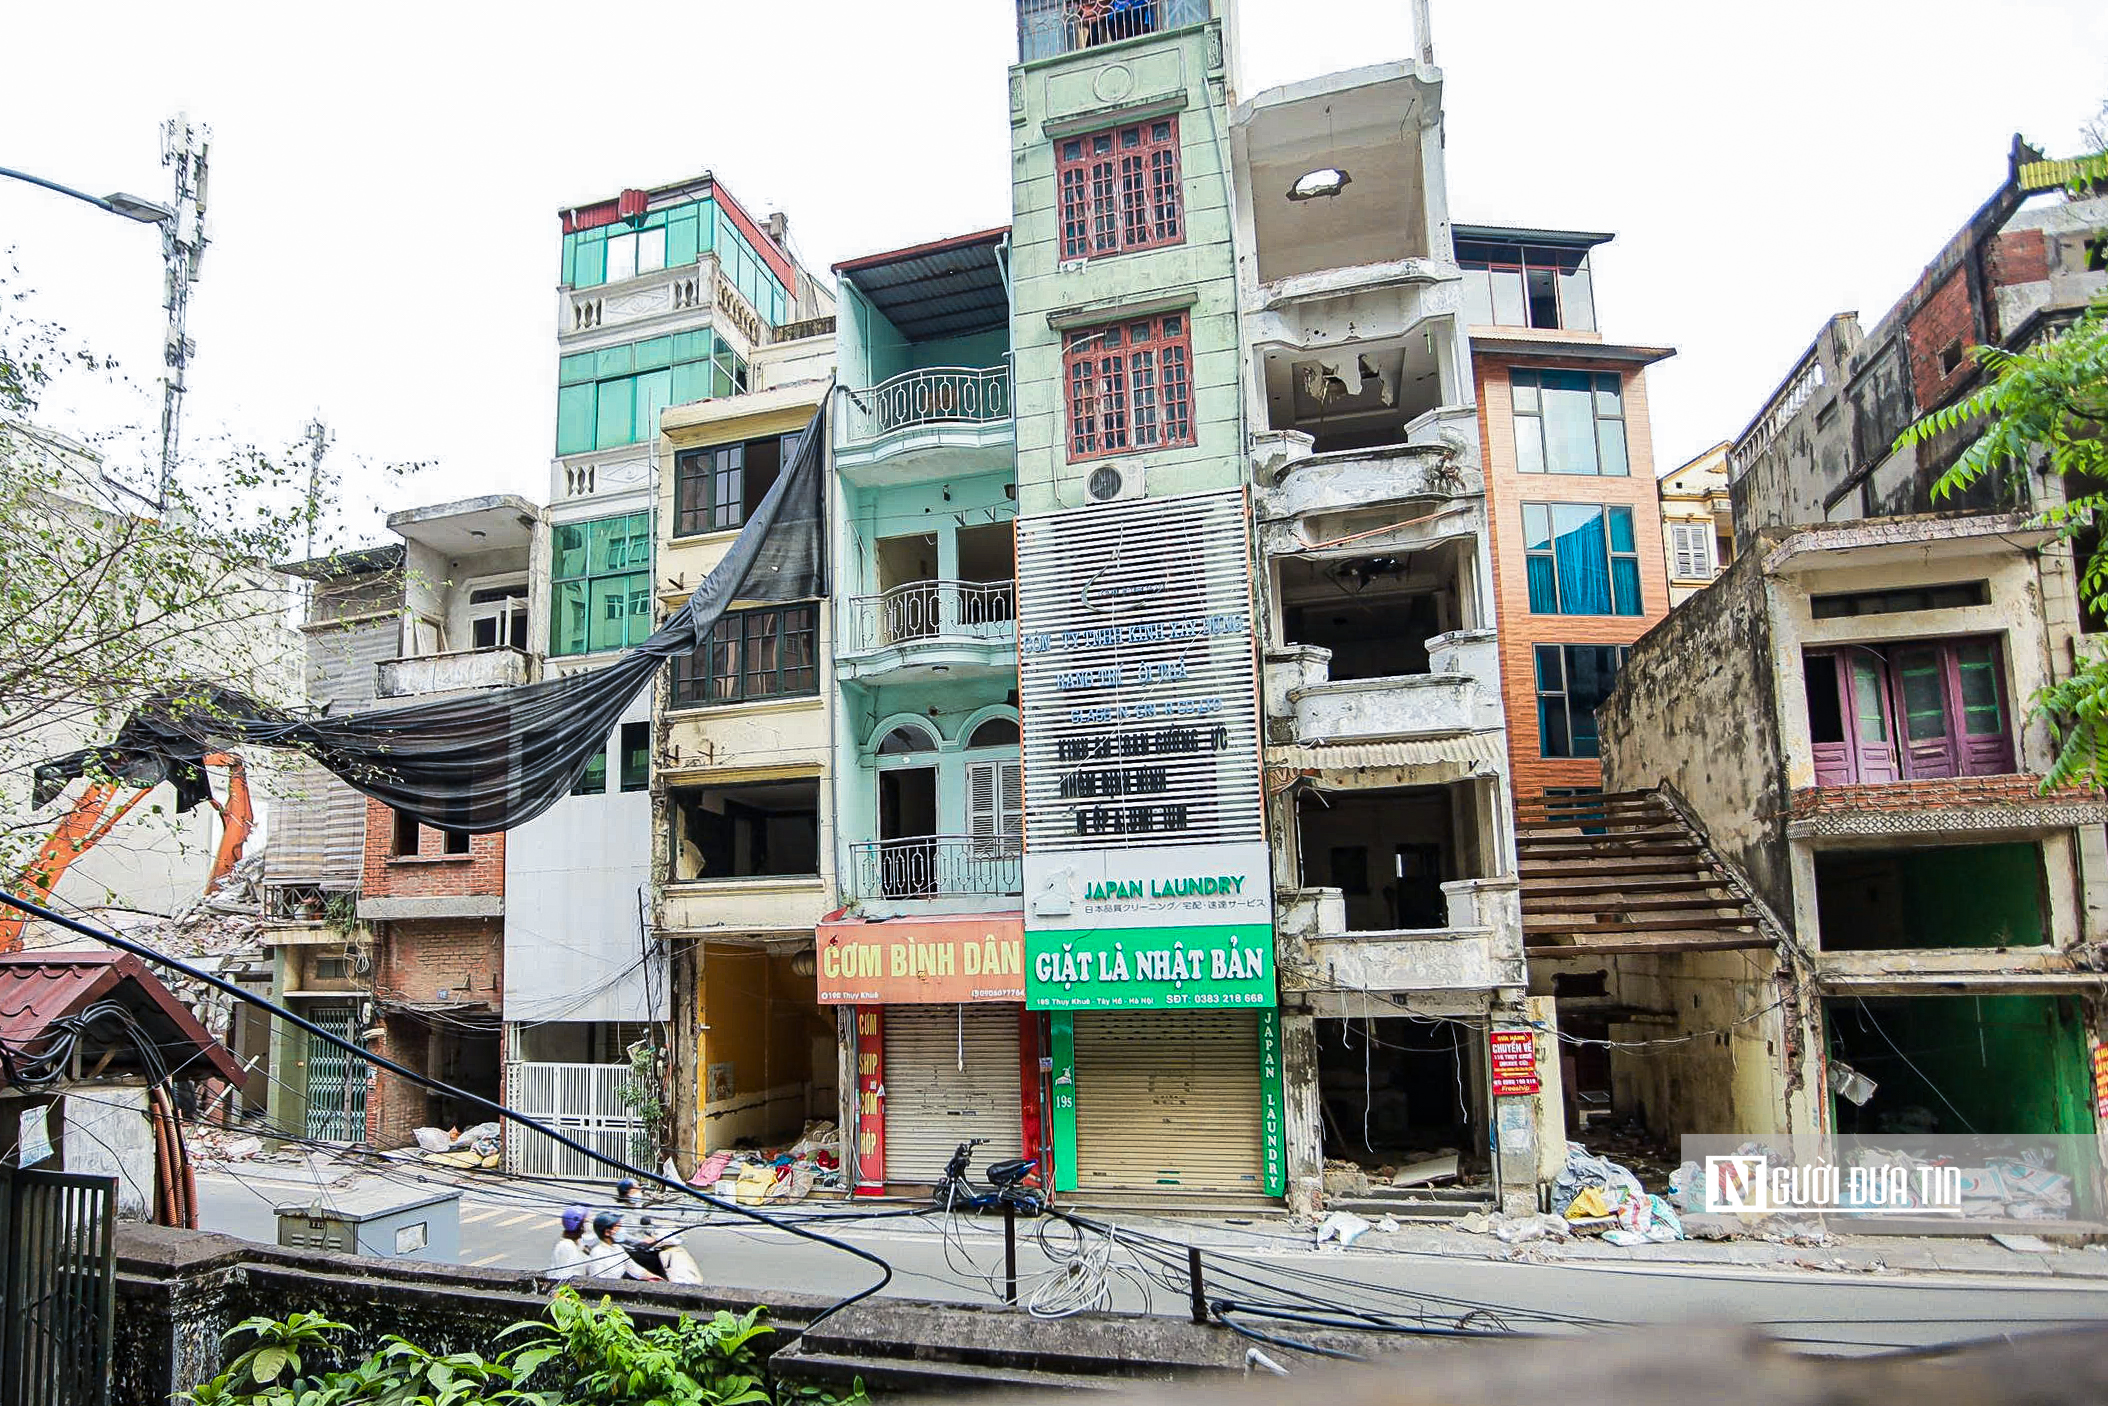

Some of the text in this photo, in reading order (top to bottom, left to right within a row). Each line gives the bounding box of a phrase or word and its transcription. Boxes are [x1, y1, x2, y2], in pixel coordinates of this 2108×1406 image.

[1084, 875, 1245, 900] JAPAN LAUNDRY
[823, 933, 1021, 978] CƠM BÌNH DÂN
[1035, 934, 1264, 990] GIẶT LÀ NHẬT BẢN
[1194, 994, 1220, 1004] 0383
[1223, 993, 1242, 1003] 218
[858, 1011, 877, 1036] CƠM
[858, 1053, 878, 1075] SHIP
[1264, 1012, 1278, 1189] JAPAN LAUNDRY
[860, 1128, 877, 1160] HỘP
